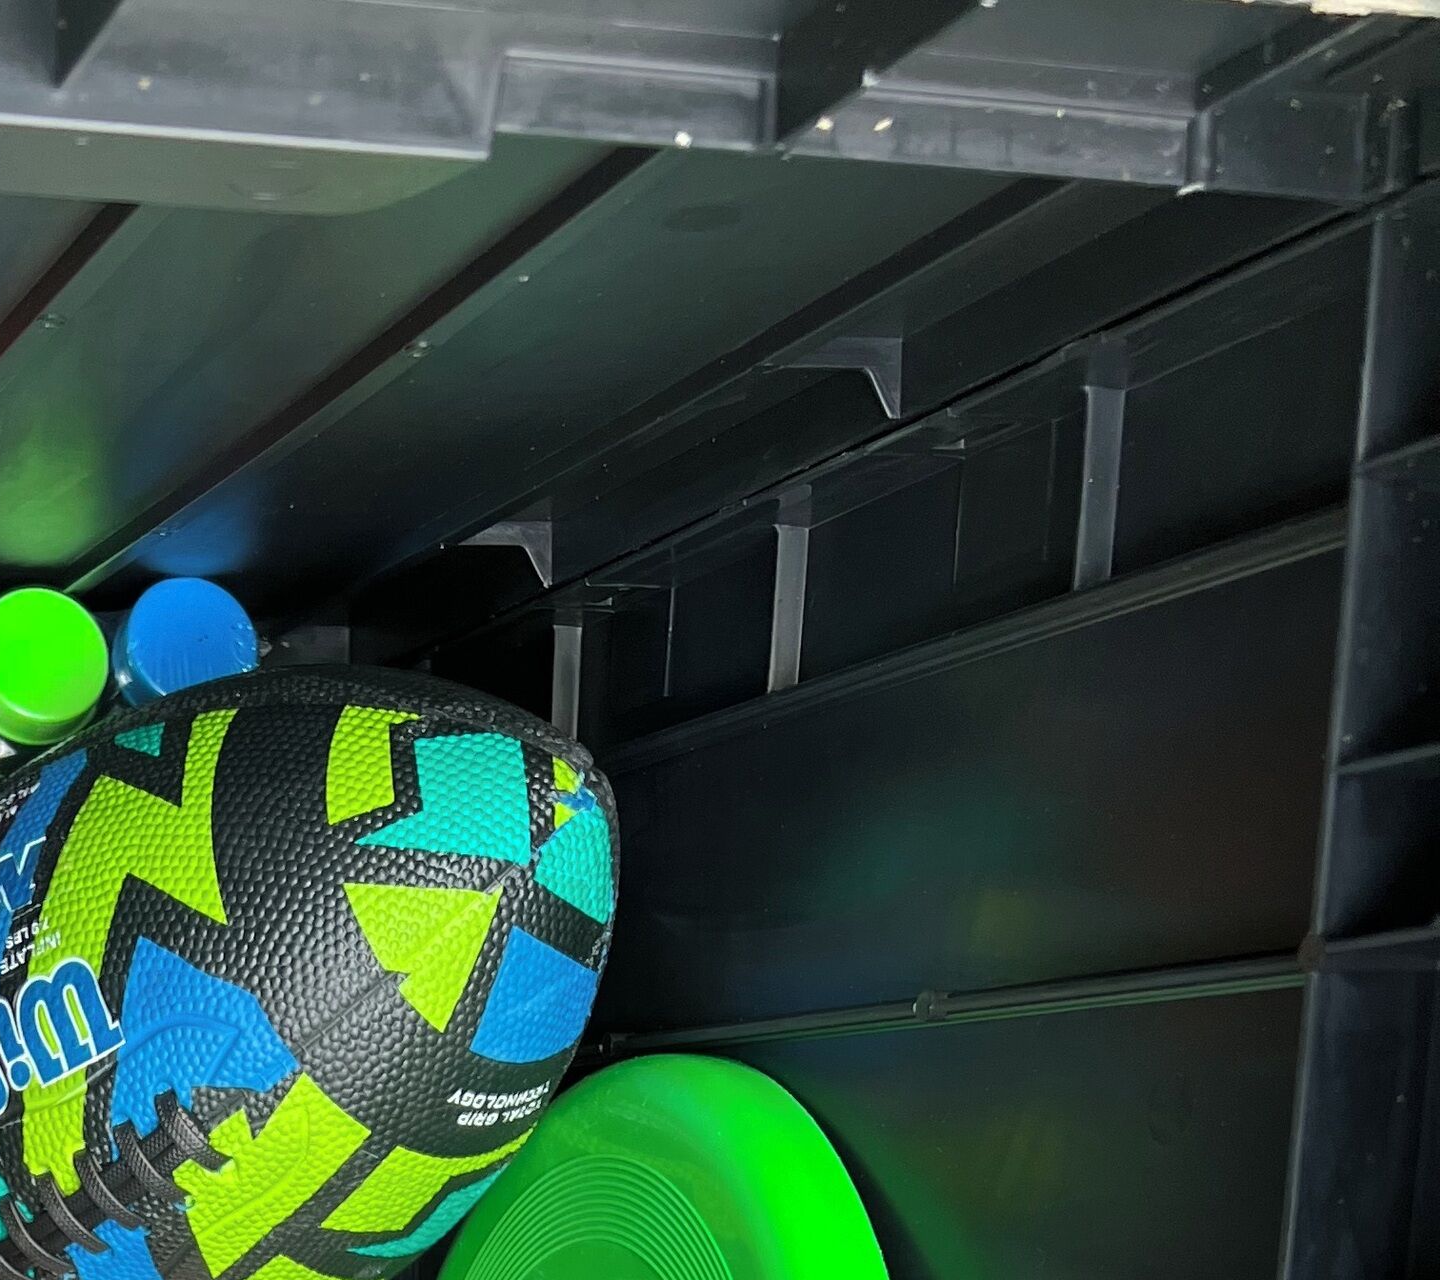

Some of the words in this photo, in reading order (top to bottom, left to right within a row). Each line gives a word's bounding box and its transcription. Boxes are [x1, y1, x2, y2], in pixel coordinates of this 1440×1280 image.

[0, 930, 61, 976] INFLATE
[446, 1079, 551, 1109] TECHNOLOGY
[456, 1110, 499, 1127] GRIP
